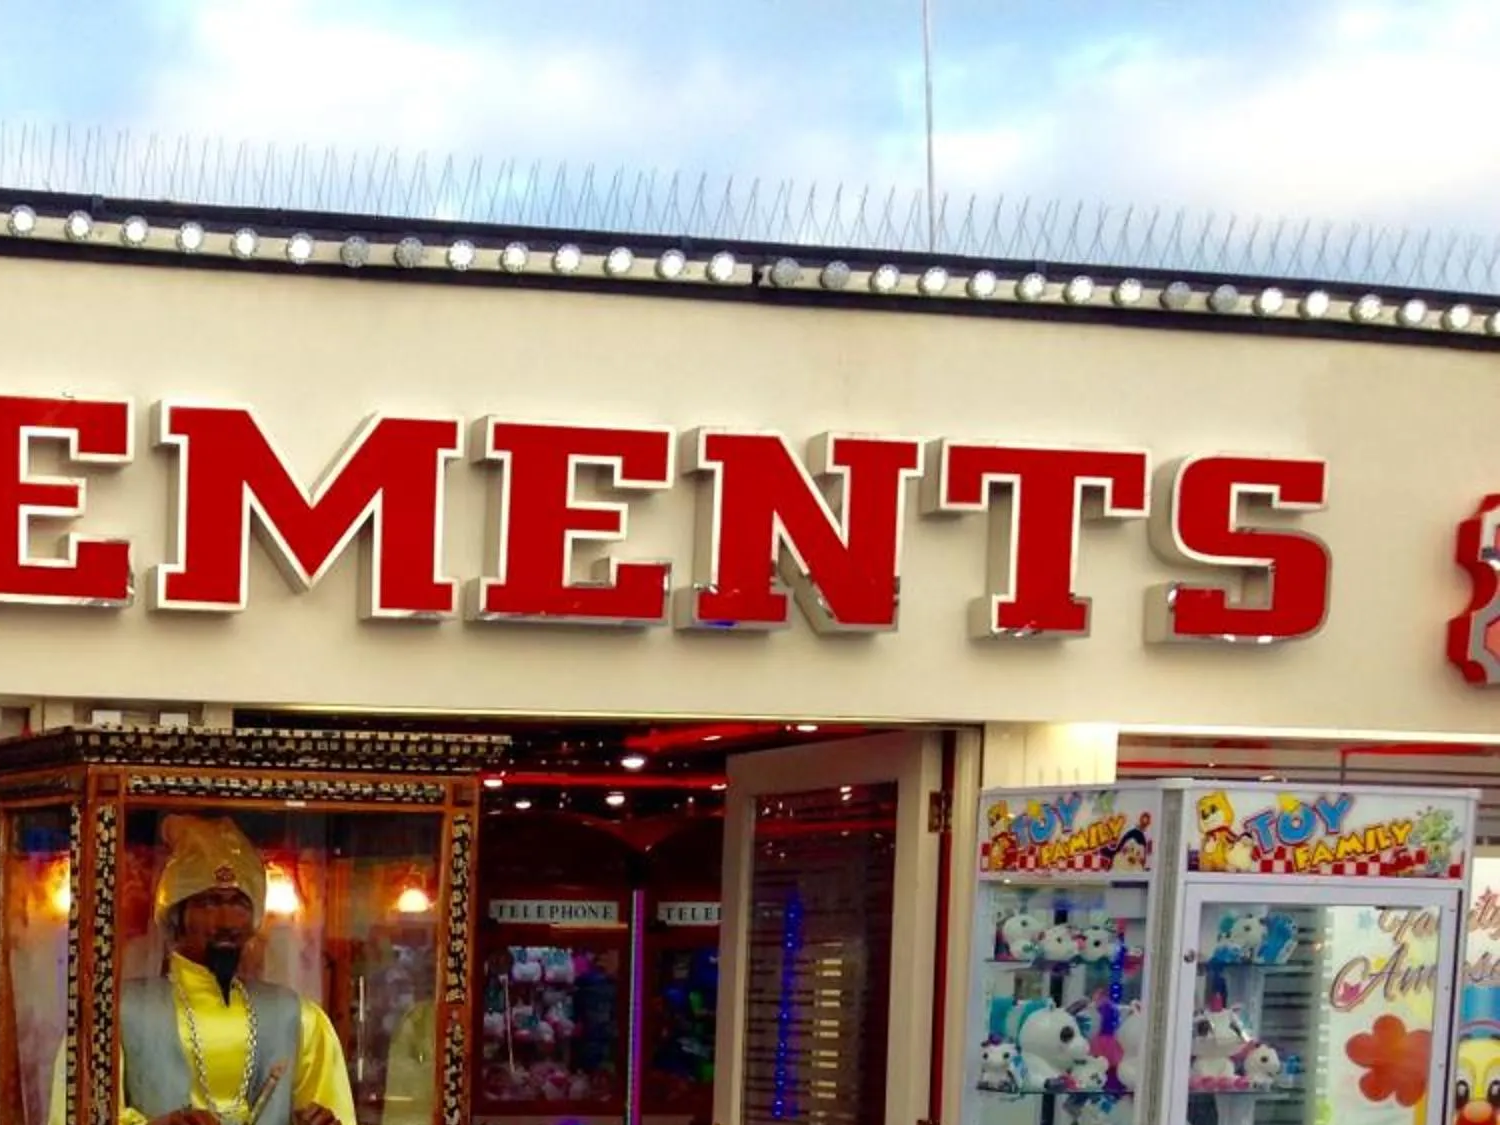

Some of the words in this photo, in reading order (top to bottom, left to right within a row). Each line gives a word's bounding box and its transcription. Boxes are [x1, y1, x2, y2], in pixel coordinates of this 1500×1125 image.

[1011, 790, 1082, 847] TOY
[1038, 813, 1126, 866] FAMILY
[1245, 793, 1356, 853] TOY
[1294, 817, 1412, 873] FAMILY
[497, 903, 614, 920] TELEPHONE
